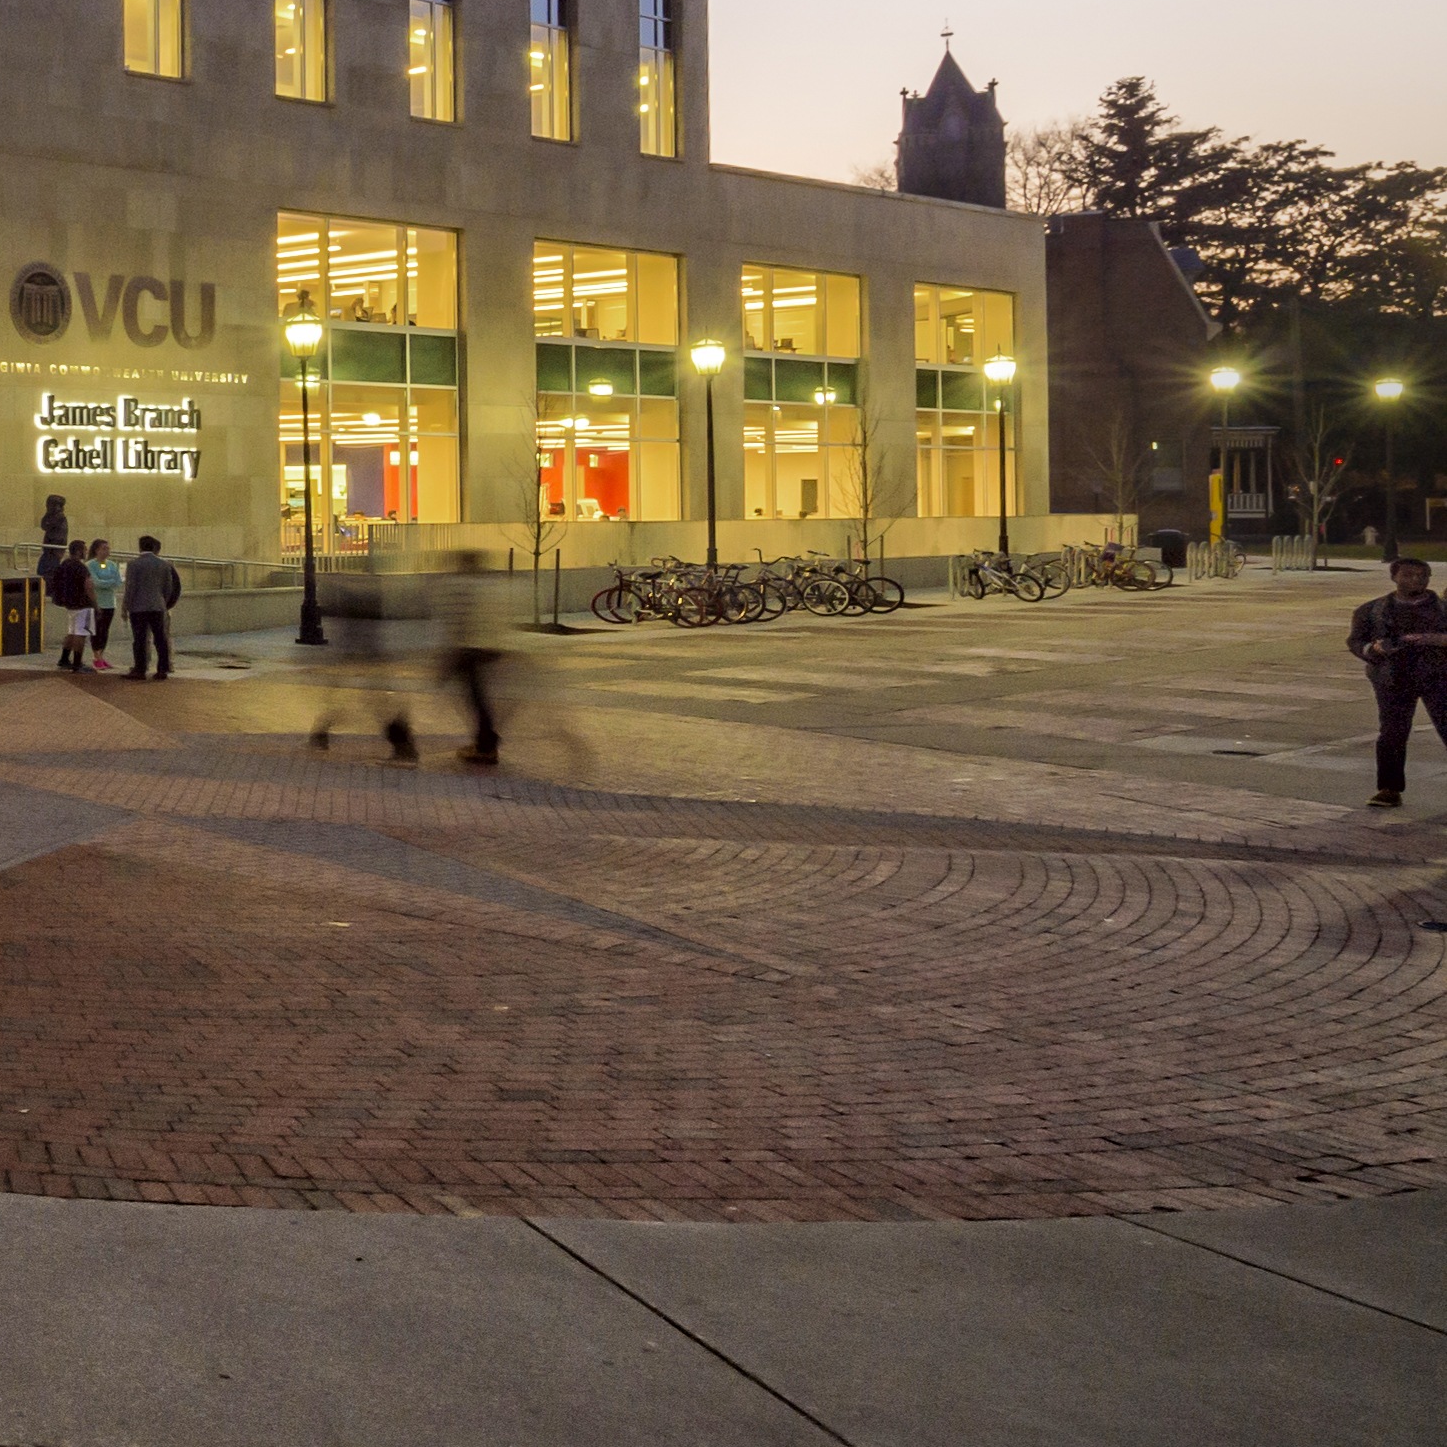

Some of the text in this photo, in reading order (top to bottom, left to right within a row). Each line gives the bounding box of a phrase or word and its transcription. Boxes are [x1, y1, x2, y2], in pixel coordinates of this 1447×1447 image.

[73, 271, 216, 350] VCU
[49, 363, 164, 379] COMMOWEALTH
[171, 370, 249, 384] UNIVERSITY
[37, 394, 202, 430] James Branch
[40, 437, 202, 479] Cabell Library
